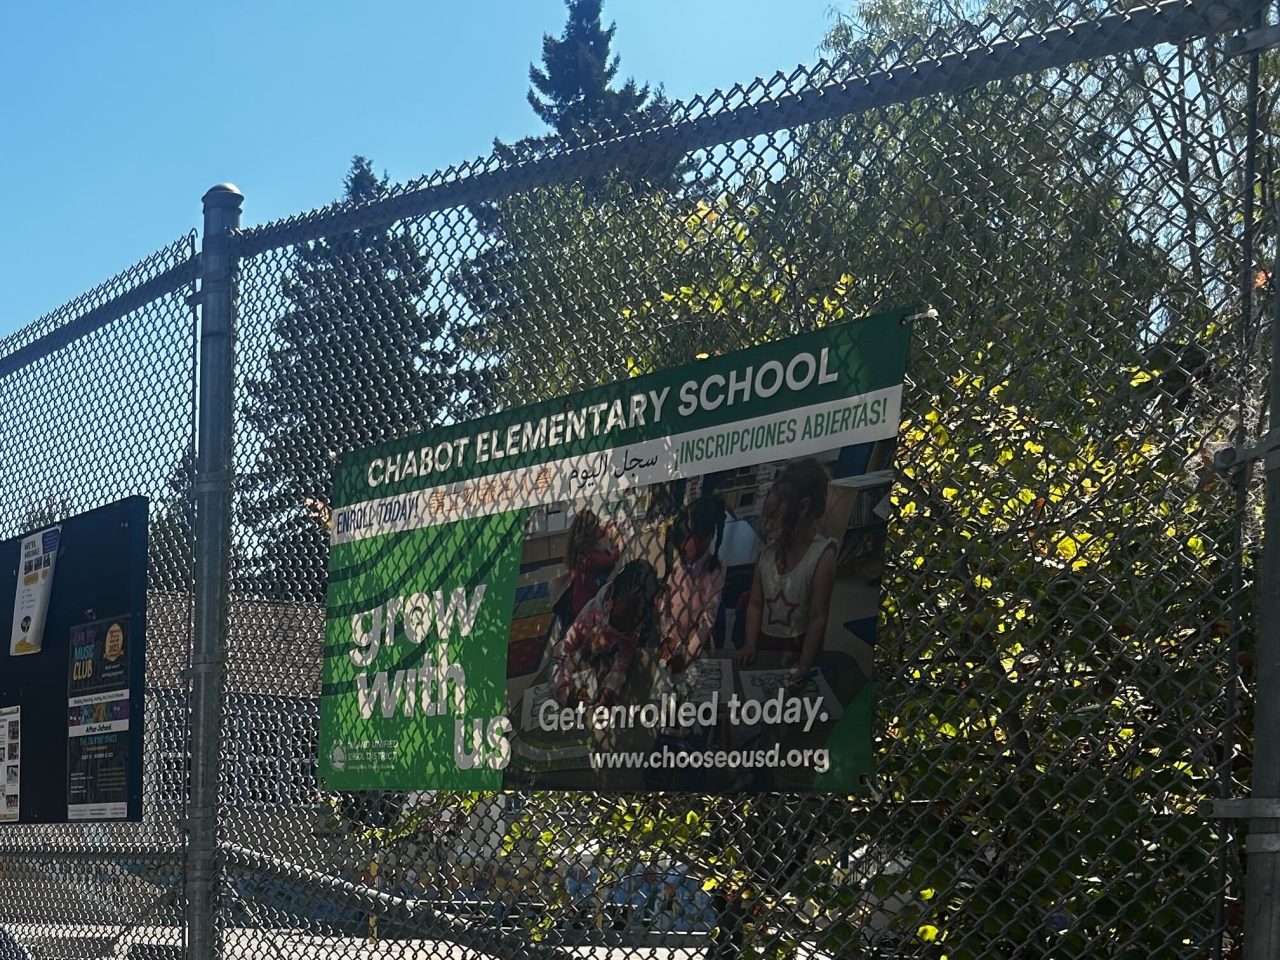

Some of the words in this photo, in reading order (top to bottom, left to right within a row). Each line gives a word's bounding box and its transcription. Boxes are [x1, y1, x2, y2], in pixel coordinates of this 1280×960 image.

[368, 437, 469, 487] CHABOT
[477, 387, 670, 463] ELEMENTARY
[678, 348, 838, 416] SCHOOL
[801, 398, 887, 441] ABIERTAS!
[337, 505, 374, 534] ENROLL
[377, 495, 419, 523] TODAY!
[349, 584, 487, 667] grow
[73, 659, 93, 681] CLUB
[356, 643, 466, 719] with
[538, 700, 585, 731] Get
[592, 691, 718, 728] enrolled
[727, 688, 829, 732] today.
[454, 716, 512, 770] us
[589, 743, 830, 773] www.chooseousd.org
